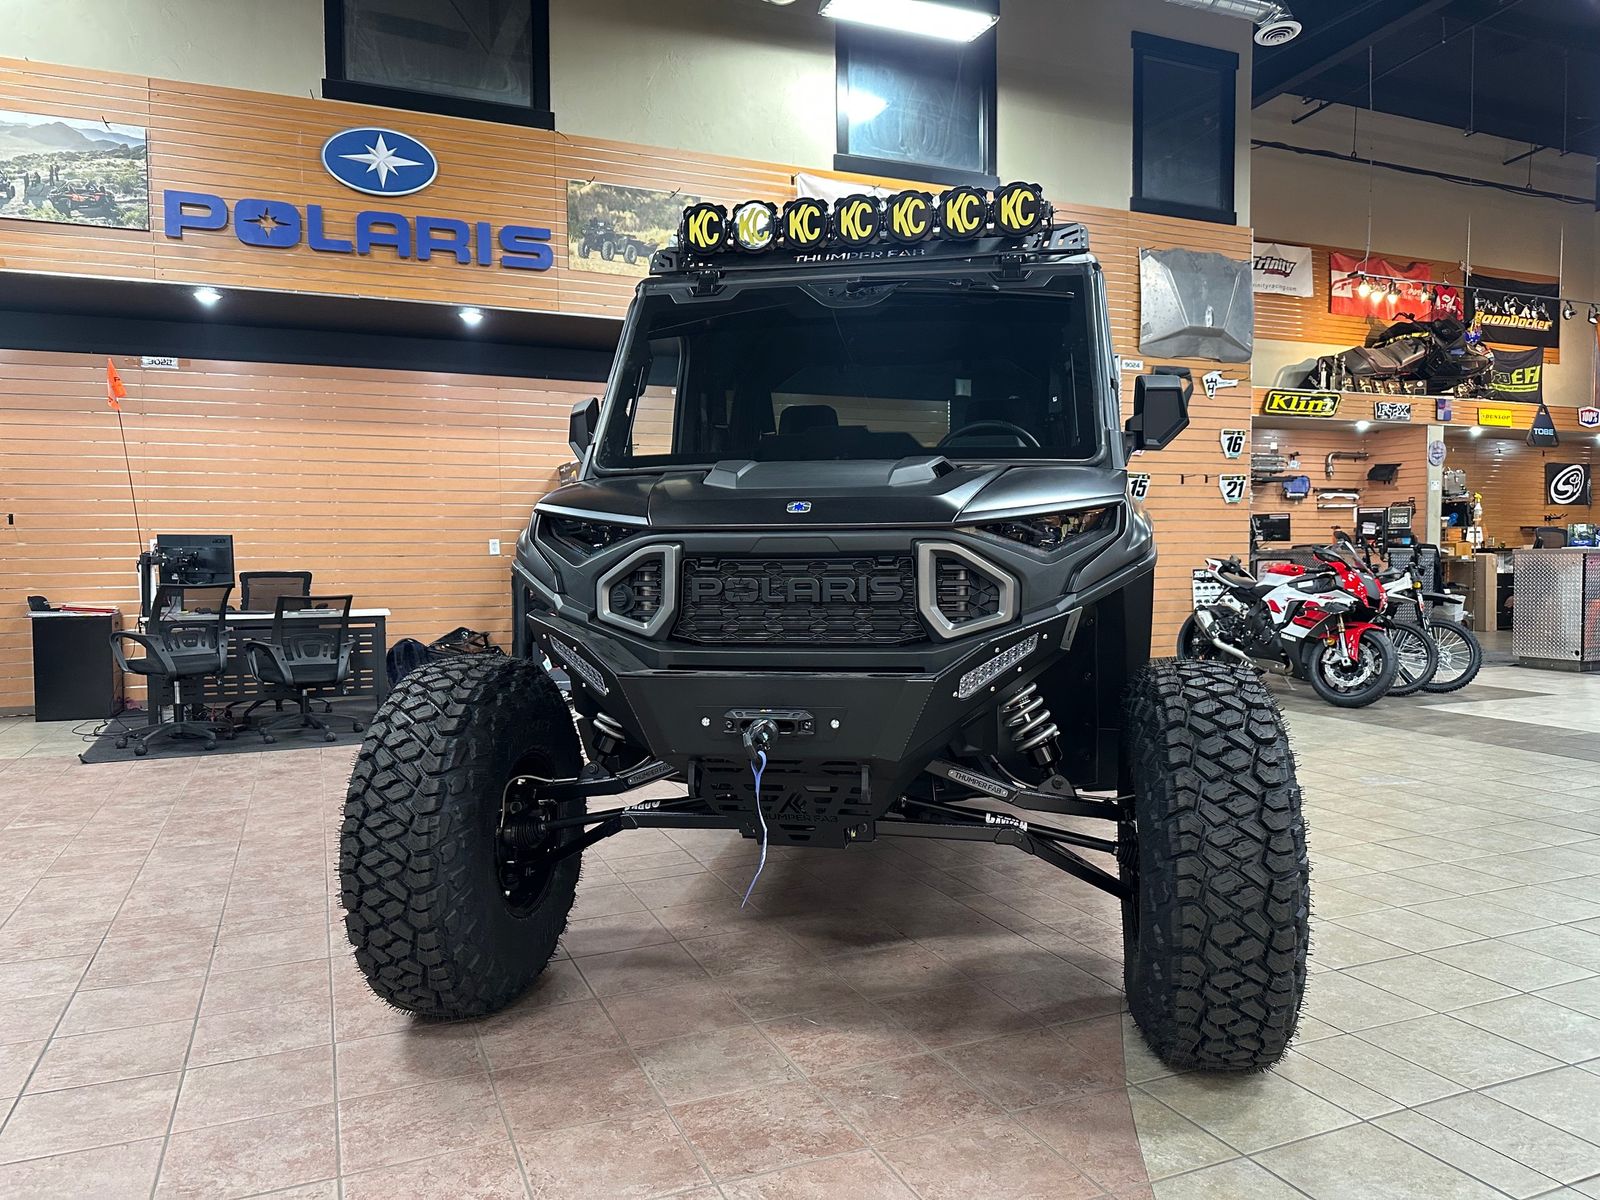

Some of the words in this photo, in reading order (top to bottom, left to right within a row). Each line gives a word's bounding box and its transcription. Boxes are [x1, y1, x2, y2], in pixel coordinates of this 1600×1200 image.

[789, 206, 821, 241] KC
[841, 201, 873, 240] KC
[893, 197, 926, 236] KC
[946, 193, 979, 233] KC
[1001, 188, 1035, 229] KC
[164, 189, 553, 271] POLARIS
[689, 209, 720, 248] KC
[739, 207, 770, 245] KC
[793, 250, 884, 264] THUMPER
[1533, 428, 1554, 436] TOBE
[1581, 411, 1599, 423] 100%
[1226, 436, 1243, 453] 16
[1131, 479, 1148, 497] 15
[1226, 481, 1244, 498] 21
[692, 577, 904, 603] POLARIS
[955, 772, 988, 790] THUMPER
[988, 783, 1002, 795] FAB
